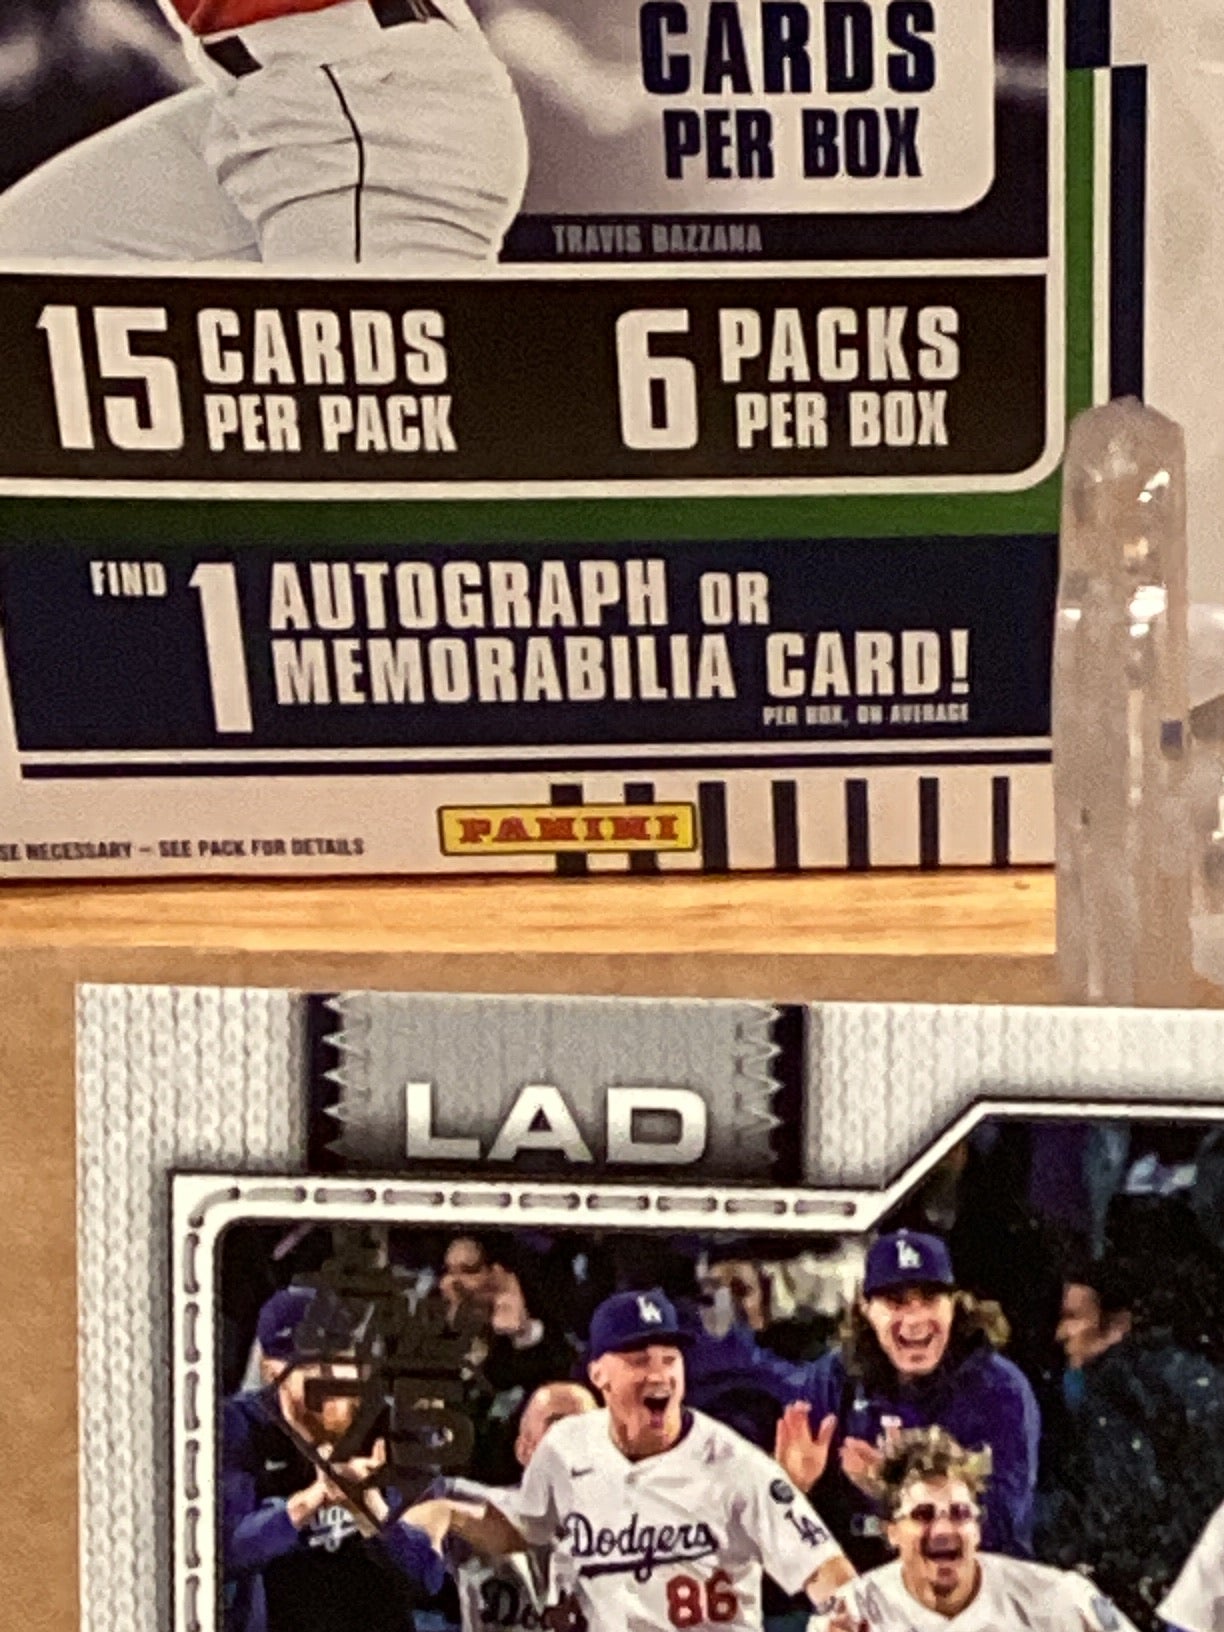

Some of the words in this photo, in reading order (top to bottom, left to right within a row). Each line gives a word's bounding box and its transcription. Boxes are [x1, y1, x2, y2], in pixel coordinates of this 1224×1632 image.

[639, 0, 936, 95] CARDS
[662, 107, 775, 180] PER
[800, 106, 922, 179] BOX
[551, 224, 643, 255] TRAVIS
[652, 223, 763, 254] BAZZANA
[36, 304, 184, 452] 15
[197, 308, 448, 386] CARDS
[614, 307, 699, 451] 6
[718, 305, 960, 384] PACKS
[203, 394, 301, 452] PER
[319, 394, 458, 453] PACK
[735, 391, 829, 450] PER
[849, 389, 949, 448] BOX
[90, 560, 168, 597] FIND
[270, 558, 669, 631] AUTOGRAPH
[700, 571, 771, 626] OR
[188, 561, 254, 734] 1
[271, 632, 737, 706] MEMORABILIA
[765, 628, 971, 698] CARD!
[158, 840, 192, 858] SEE
[198, 839, 245, 857] PACK
[251, 838, 287, 856] FOR
[291, 837, 365, 856] DETAILS
[457, 815, 680, 844] PANINI
[404, 1080, 709, 1165] LAD
[554, 1510, 720, 1584] Dodgers
[666, 1567, 739, 1630] 86
